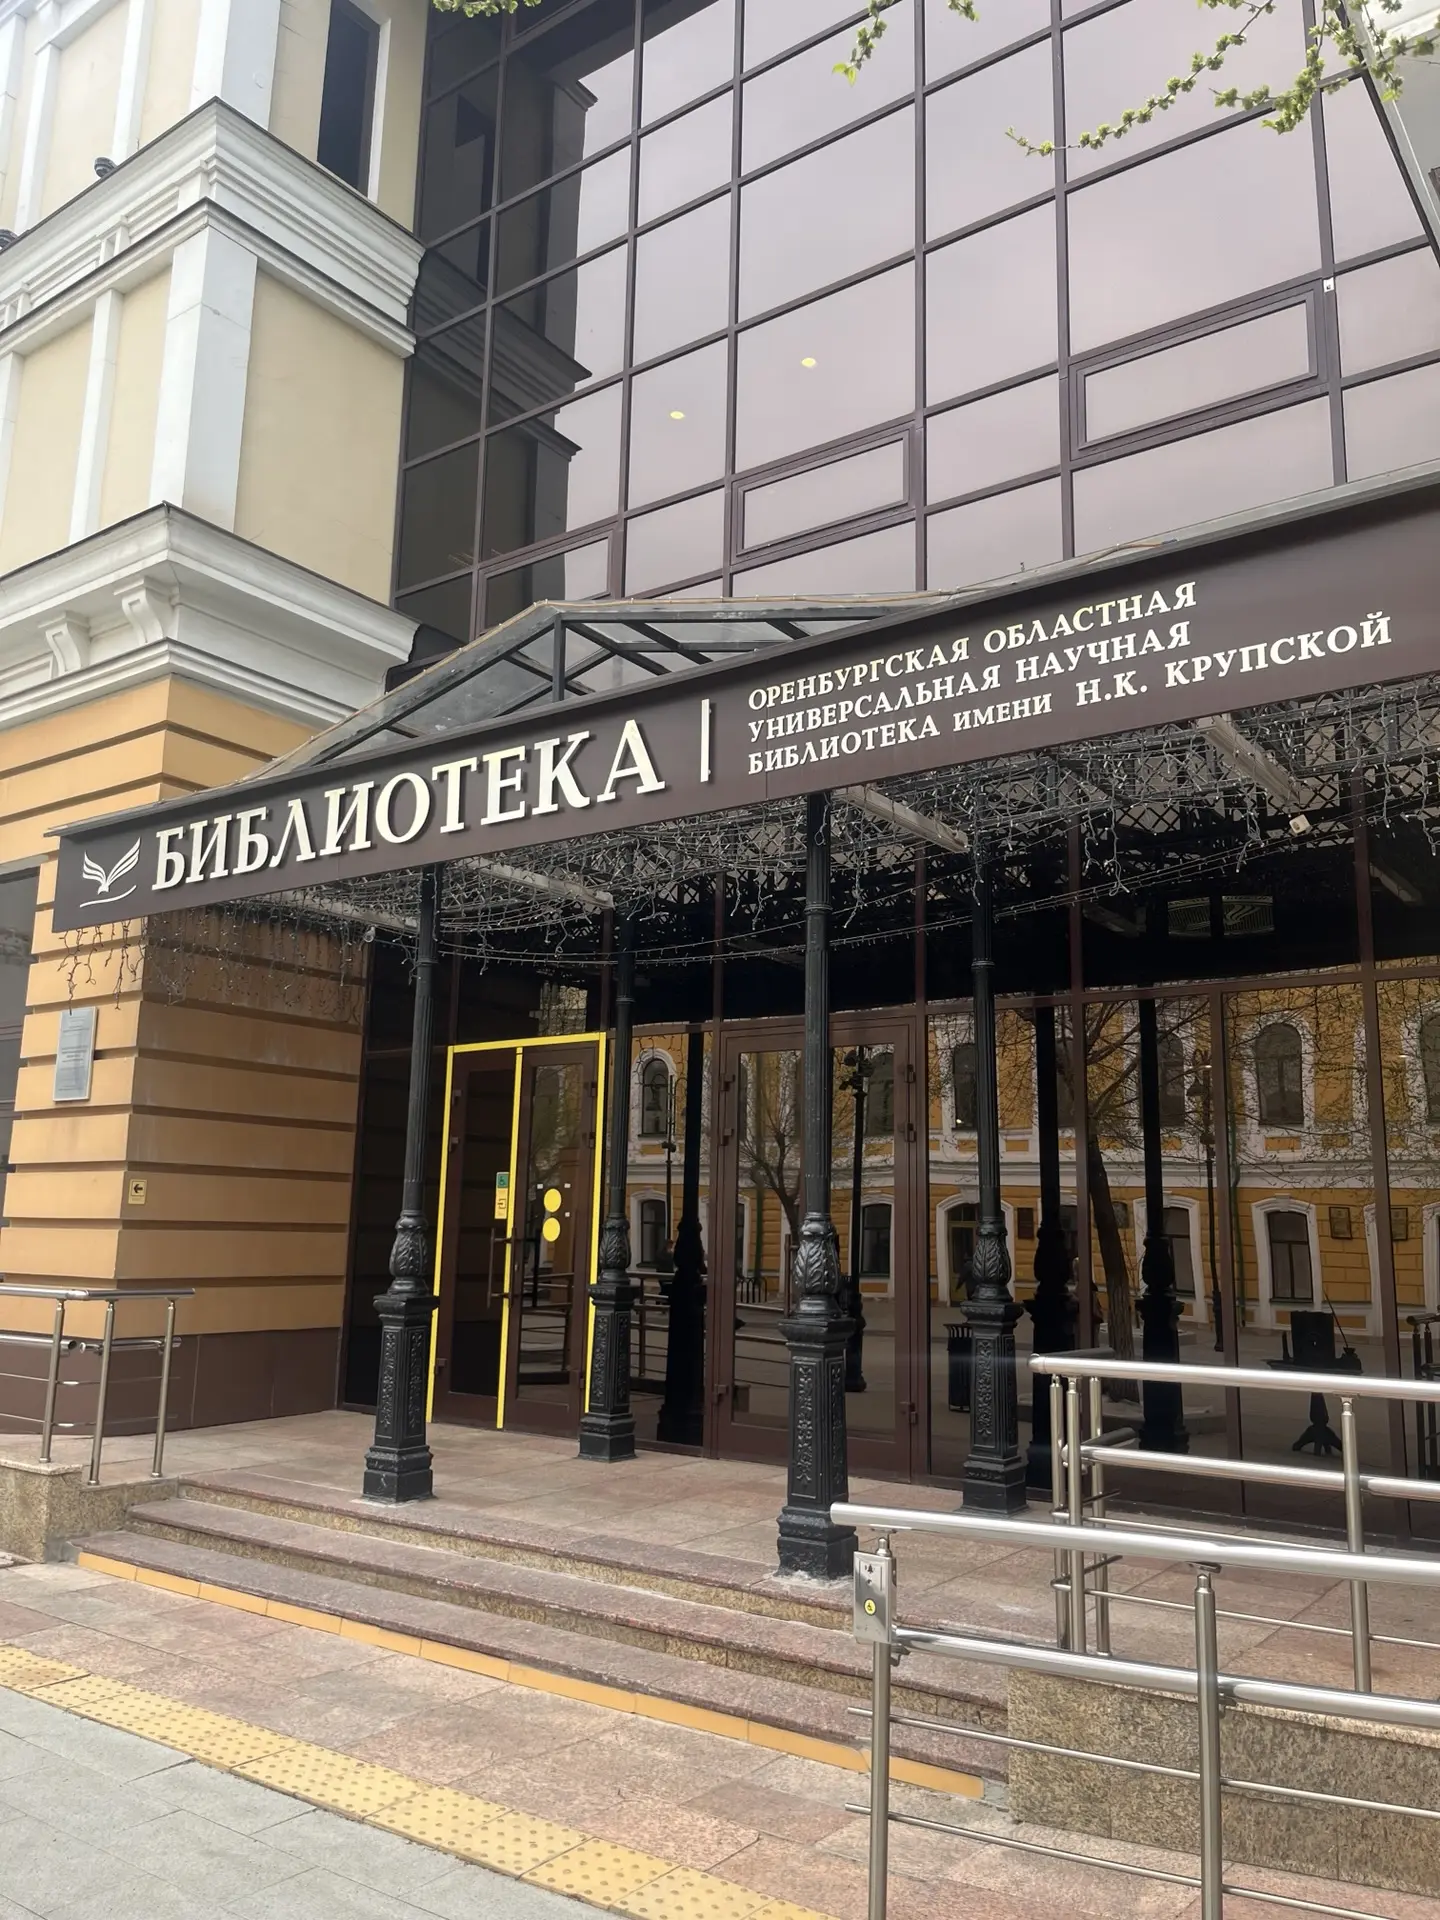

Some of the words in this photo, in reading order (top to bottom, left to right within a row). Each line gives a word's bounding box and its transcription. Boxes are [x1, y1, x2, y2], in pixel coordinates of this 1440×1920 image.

[748, 637, 970, 711] ОРЕНБУРГСКАЯ
[984, 582, 1197, 654] ОБЛАСТНАЯ
[748, 665, 1001, 743] УНИВЕРСАЛЬНАЯ
[1016, 621, 1191, 684] НАУЧНАЯ
[748, 714, 941, 775] БИБЛИОТЕКА
[1075, 670, 1148, 707] Н.К.
[1165, 610, 1392, 688] КРУПСКОЙ
[151, 718, 666, 891] БИБЛИОТЕКА
